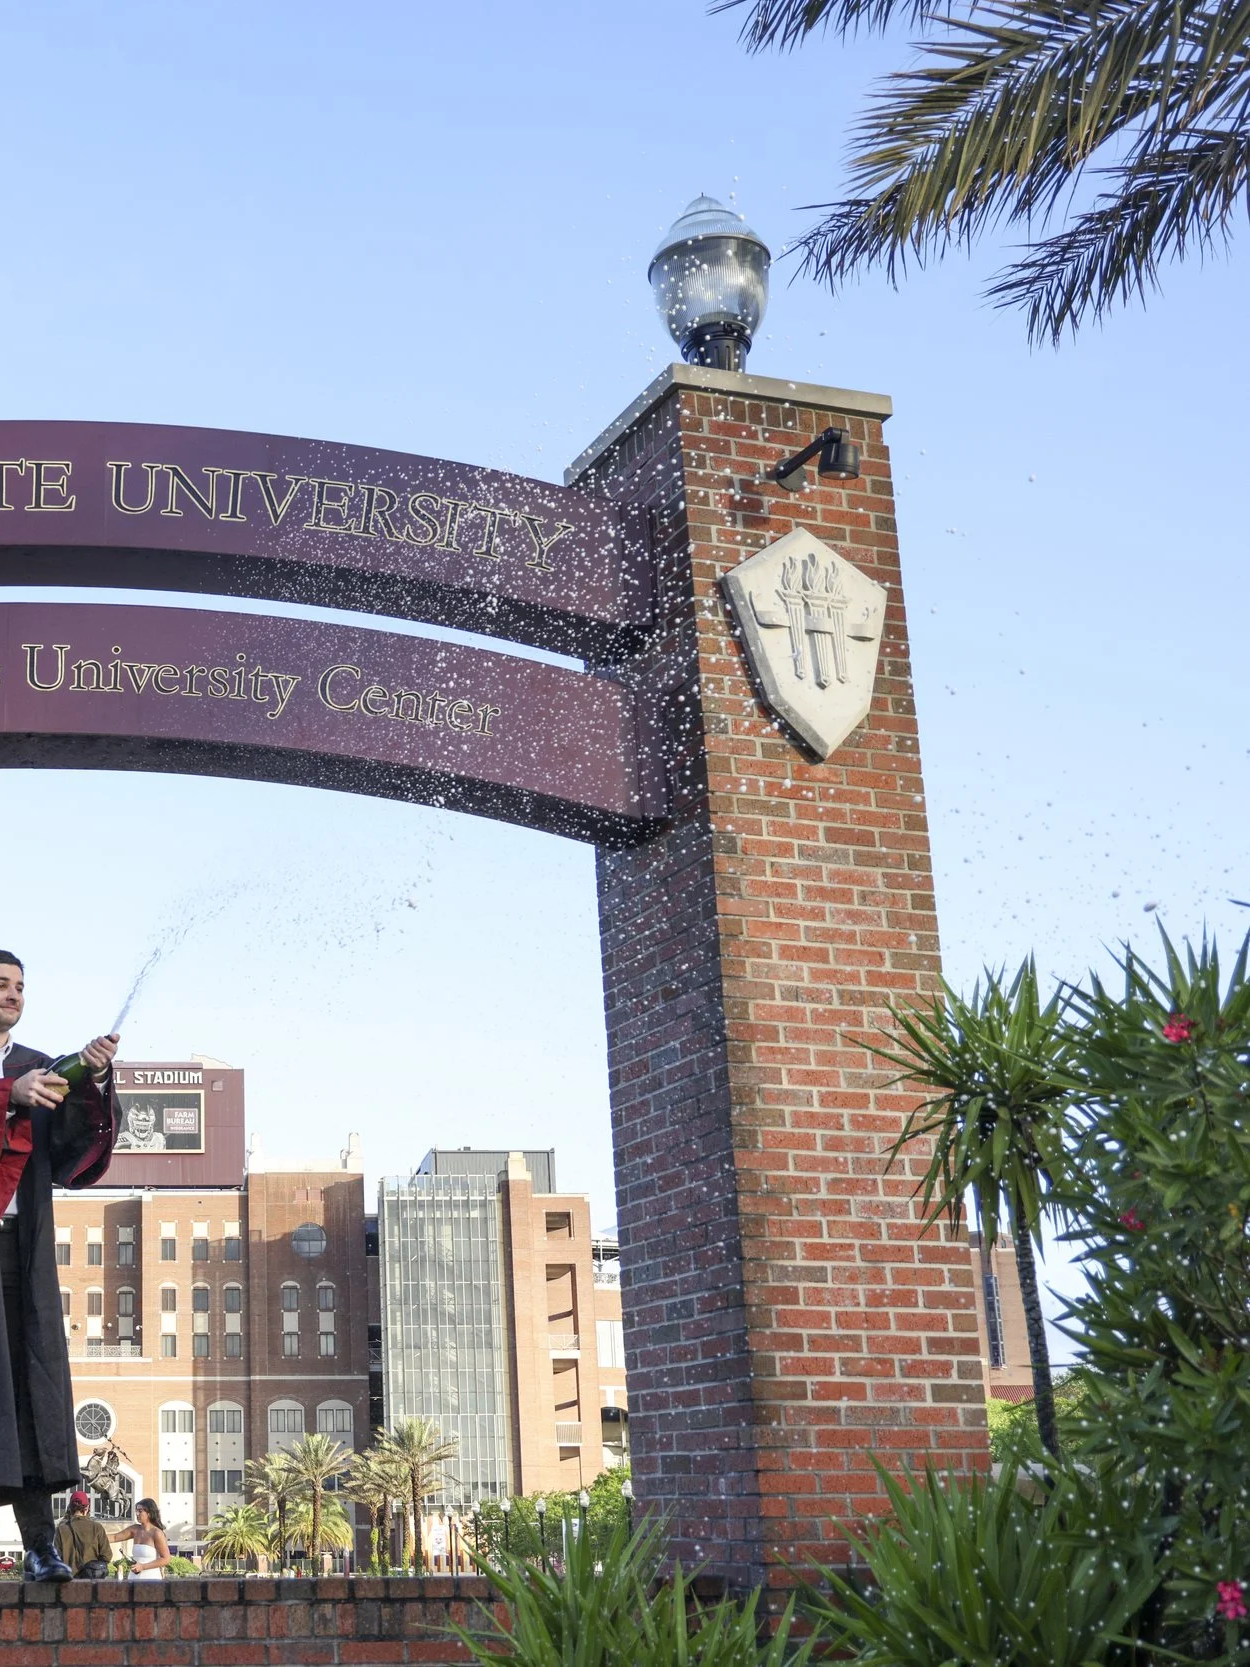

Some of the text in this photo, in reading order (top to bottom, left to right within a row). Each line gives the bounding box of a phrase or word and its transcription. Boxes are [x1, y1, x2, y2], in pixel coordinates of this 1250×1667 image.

[107, 461, 575, 573] UNIVERSITY
[22, 644, 301, 719] University
[318, 664, 502, 737] Center
[134, 1071, 203, 1084] STADIUM
